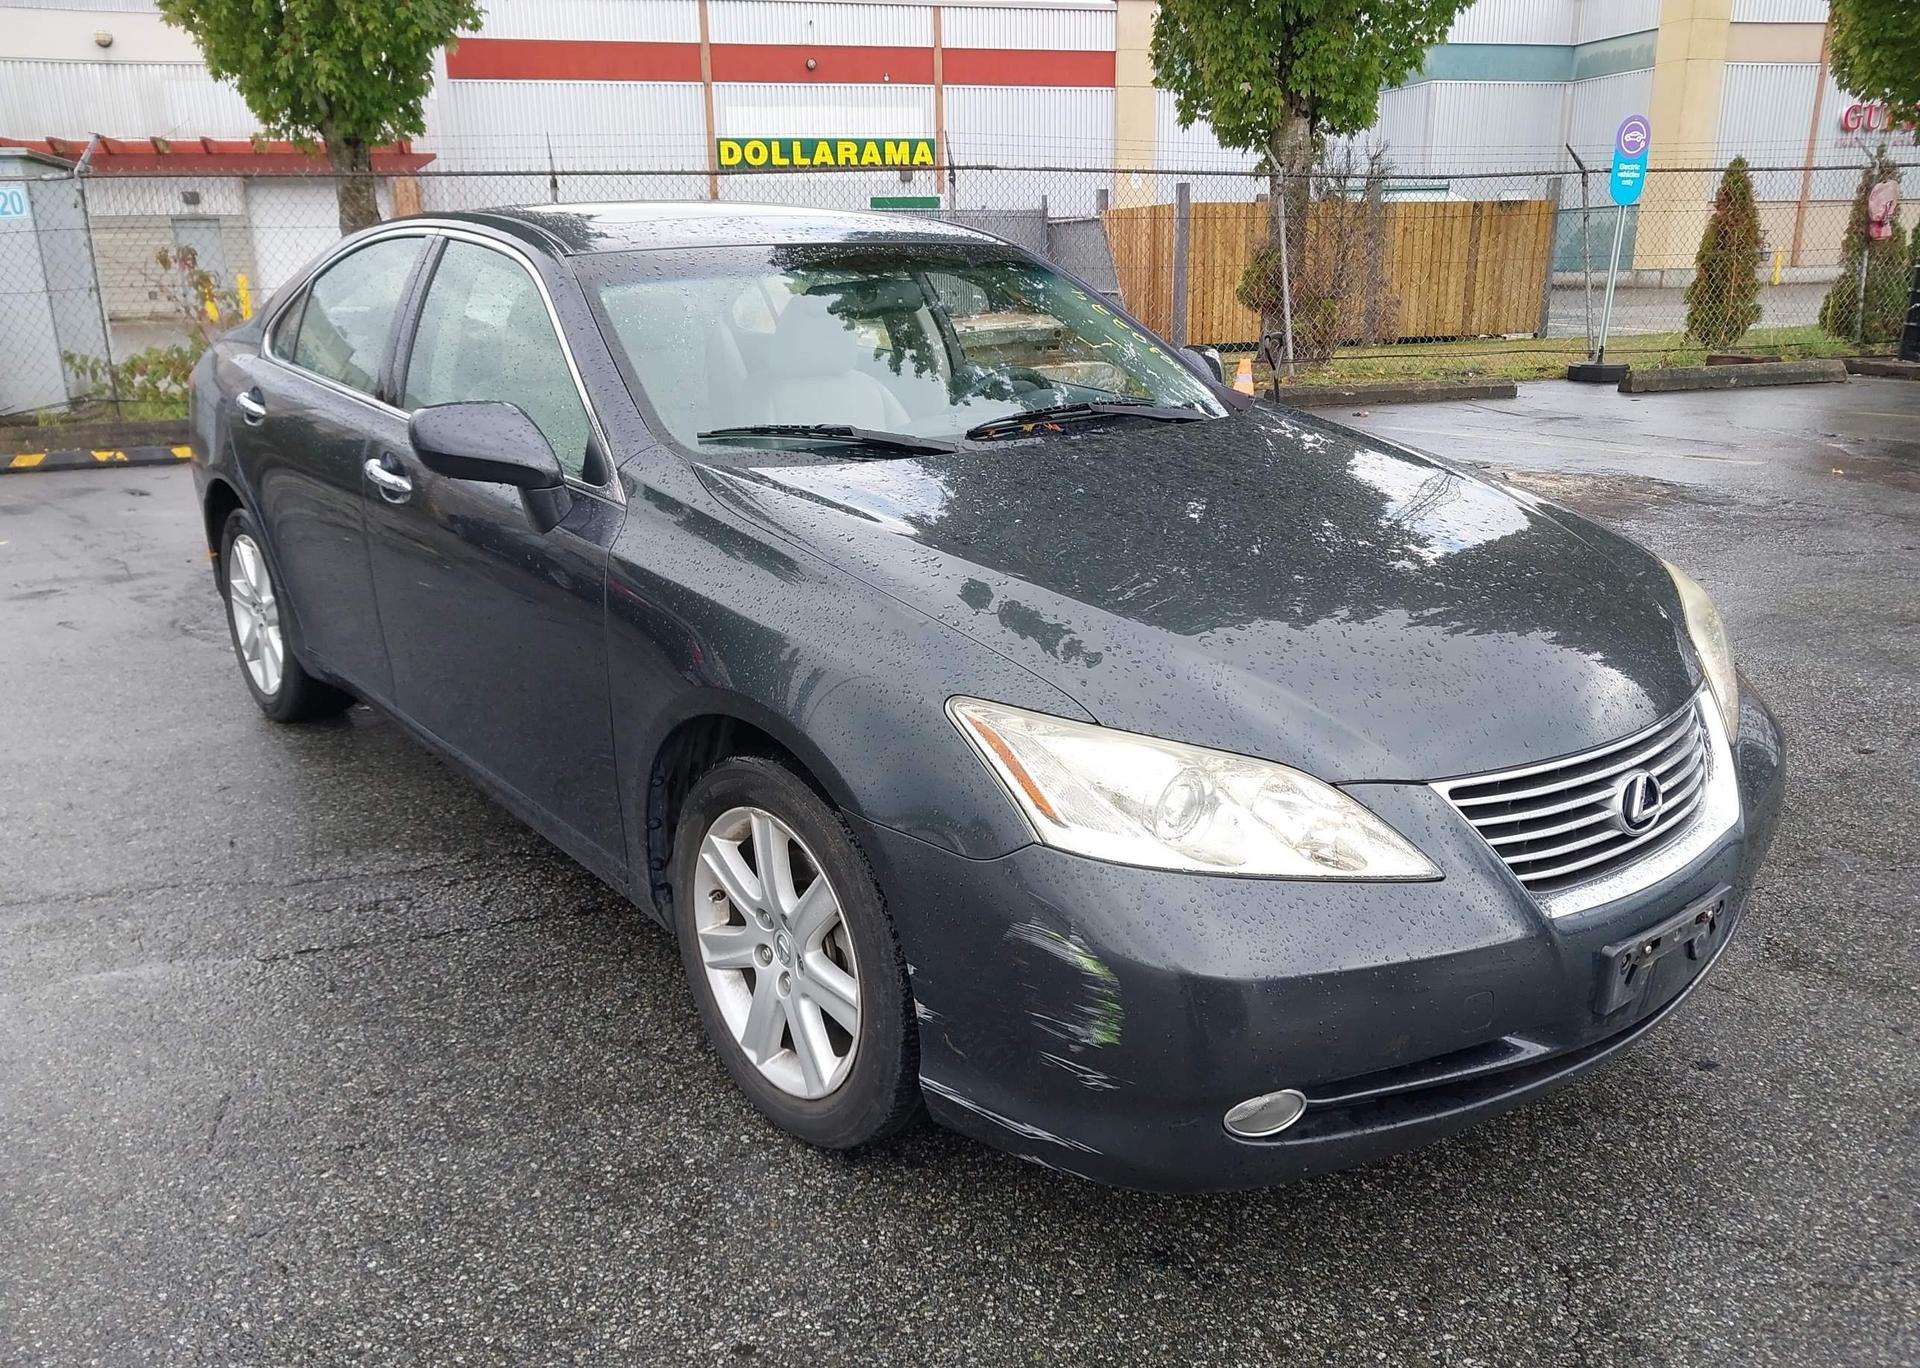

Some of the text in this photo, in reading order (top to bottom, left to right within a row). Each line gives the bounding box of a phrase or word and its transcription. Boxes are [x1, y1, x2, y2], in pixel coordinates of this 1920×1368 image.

[719, 140, 934, 167] DOLLARAMA
[1619, 163, 1641, 171] Electric
[1621, 179, 1634, 187] only
